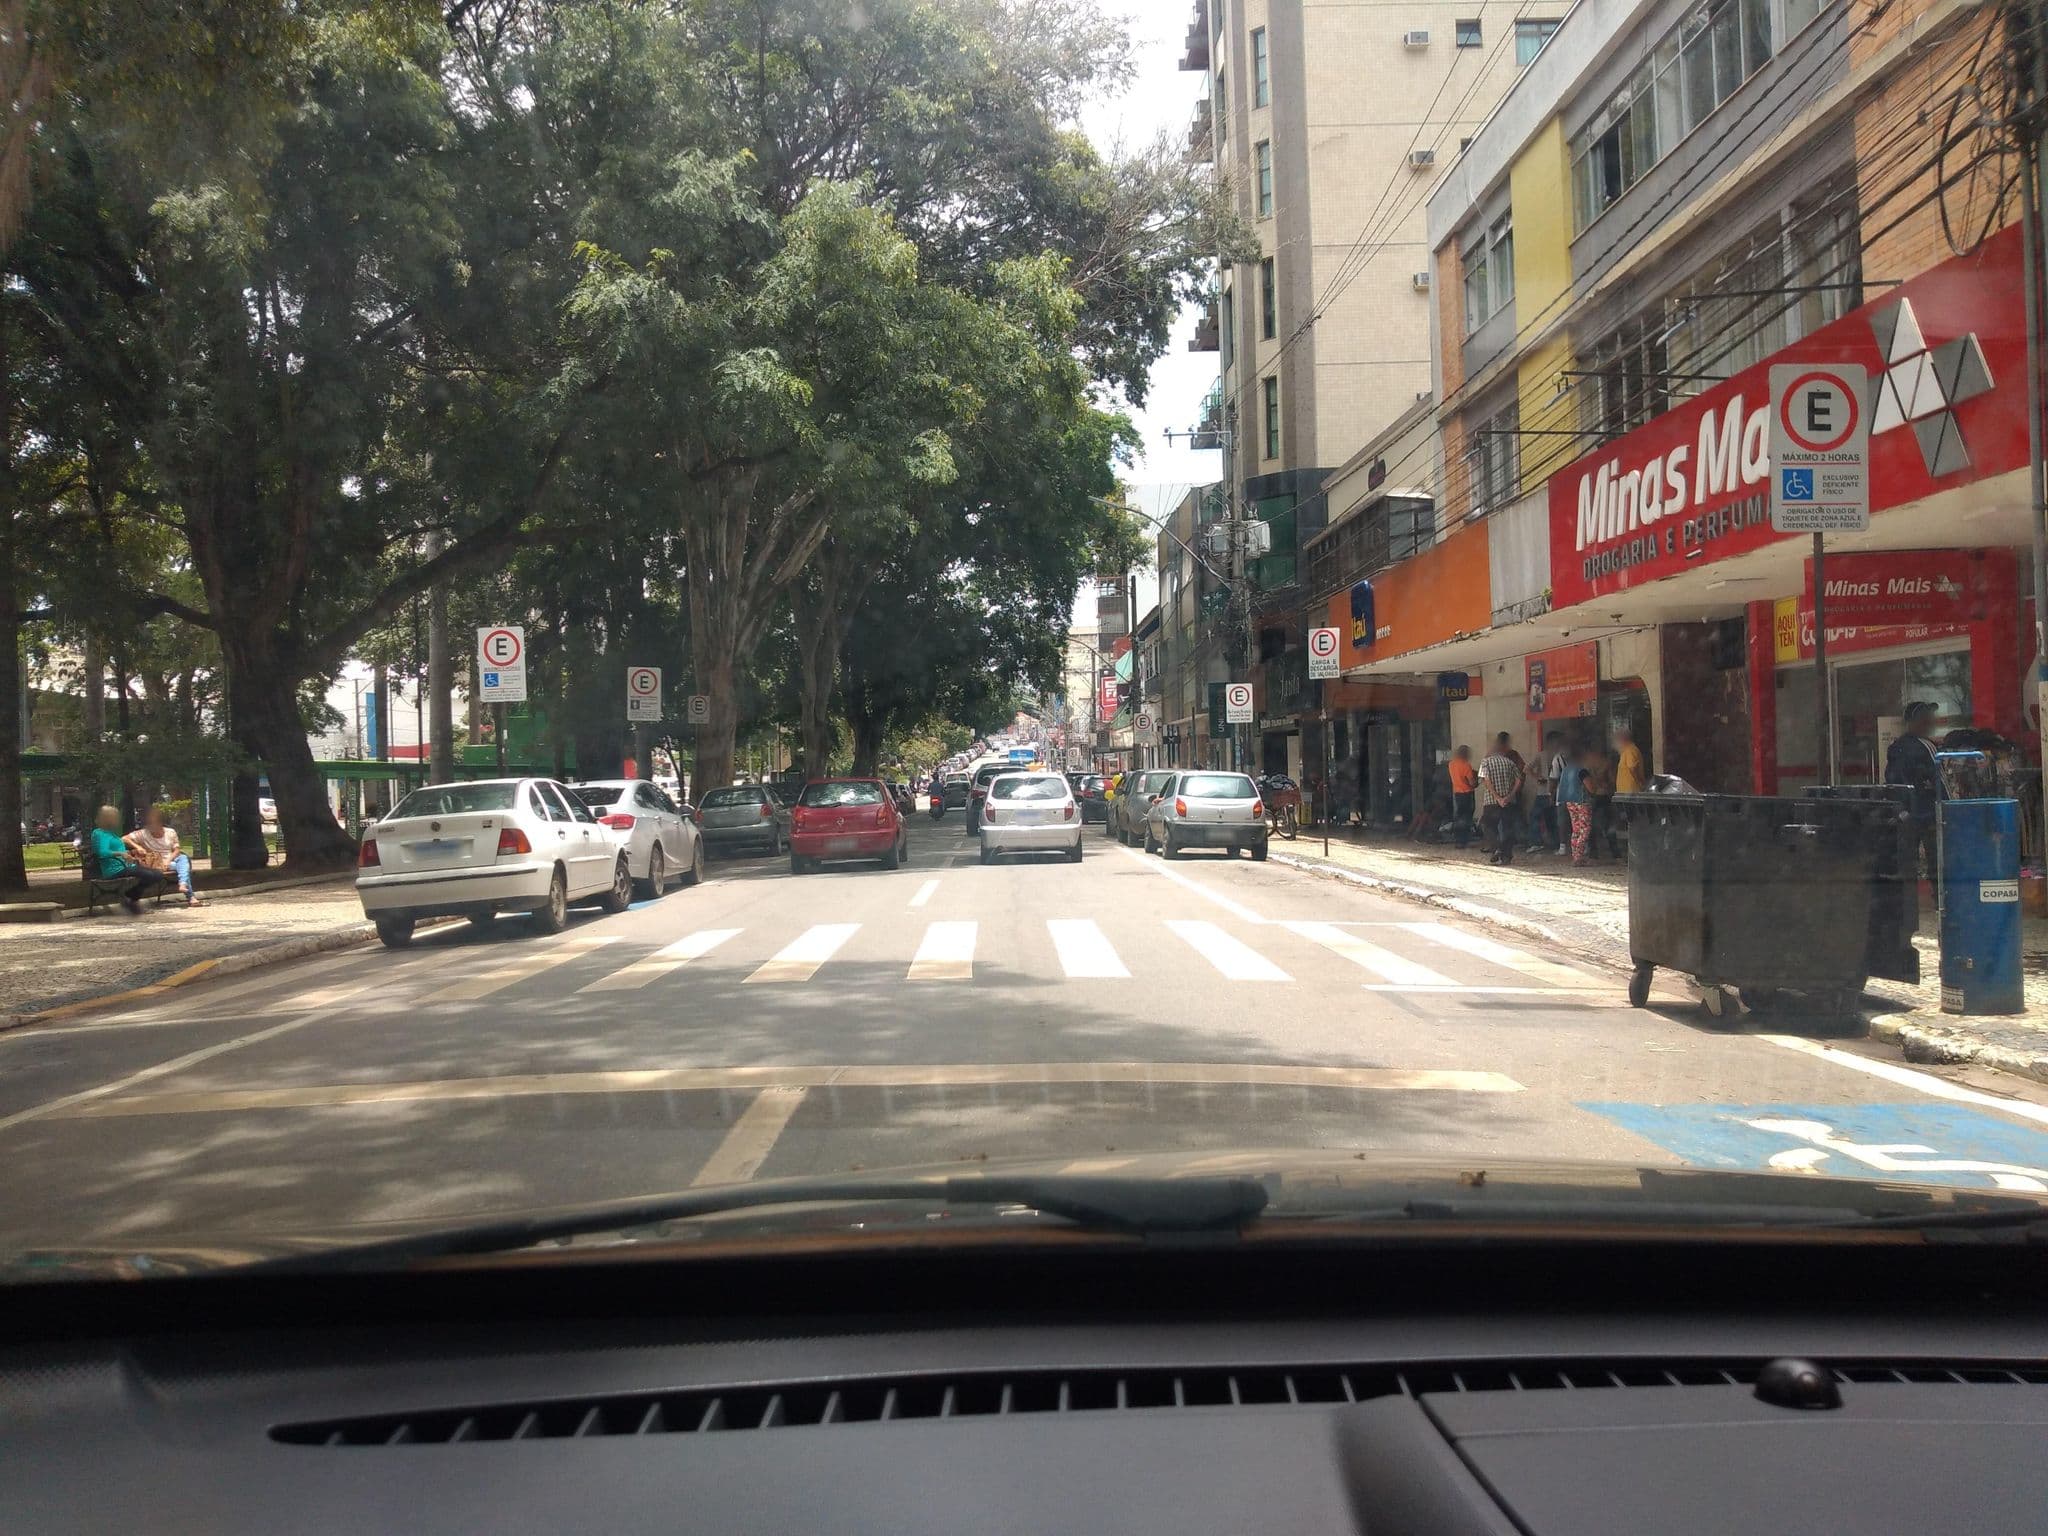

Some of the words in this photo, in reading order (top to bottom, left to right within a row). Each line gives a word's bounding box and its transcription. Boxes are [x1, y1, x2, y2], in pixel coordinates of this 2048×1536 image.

[1807, 391, 1831, 431] E
[1821, 453, 1826, 461] 2
[1828, 453, 1860, 461] HORAS
[1576, 444, 1690, 551] Minas
[1694, 394, 1770, 504] Ma
[1583, 534, 1657, 582] DROGARIA
[1682, 493, 1770, 549] PERFUM
[1824, 580, 1880, 597] Minas
[1886, 577, 1931, 595] Mais
[1777, 613, 1796, 631] AQUI
[496, 638, 508, 656] E
[1319, 634, 1329, 651] E
[1779, 631, 1795, 647] TEM
[640, 675, 649, 689] E
[1235, 690, 1244, 701] E
[694, 700, 703, 711] E
[1139, 718, 1147, 726] E
[1982, 890, 2018, 898] COPASA
